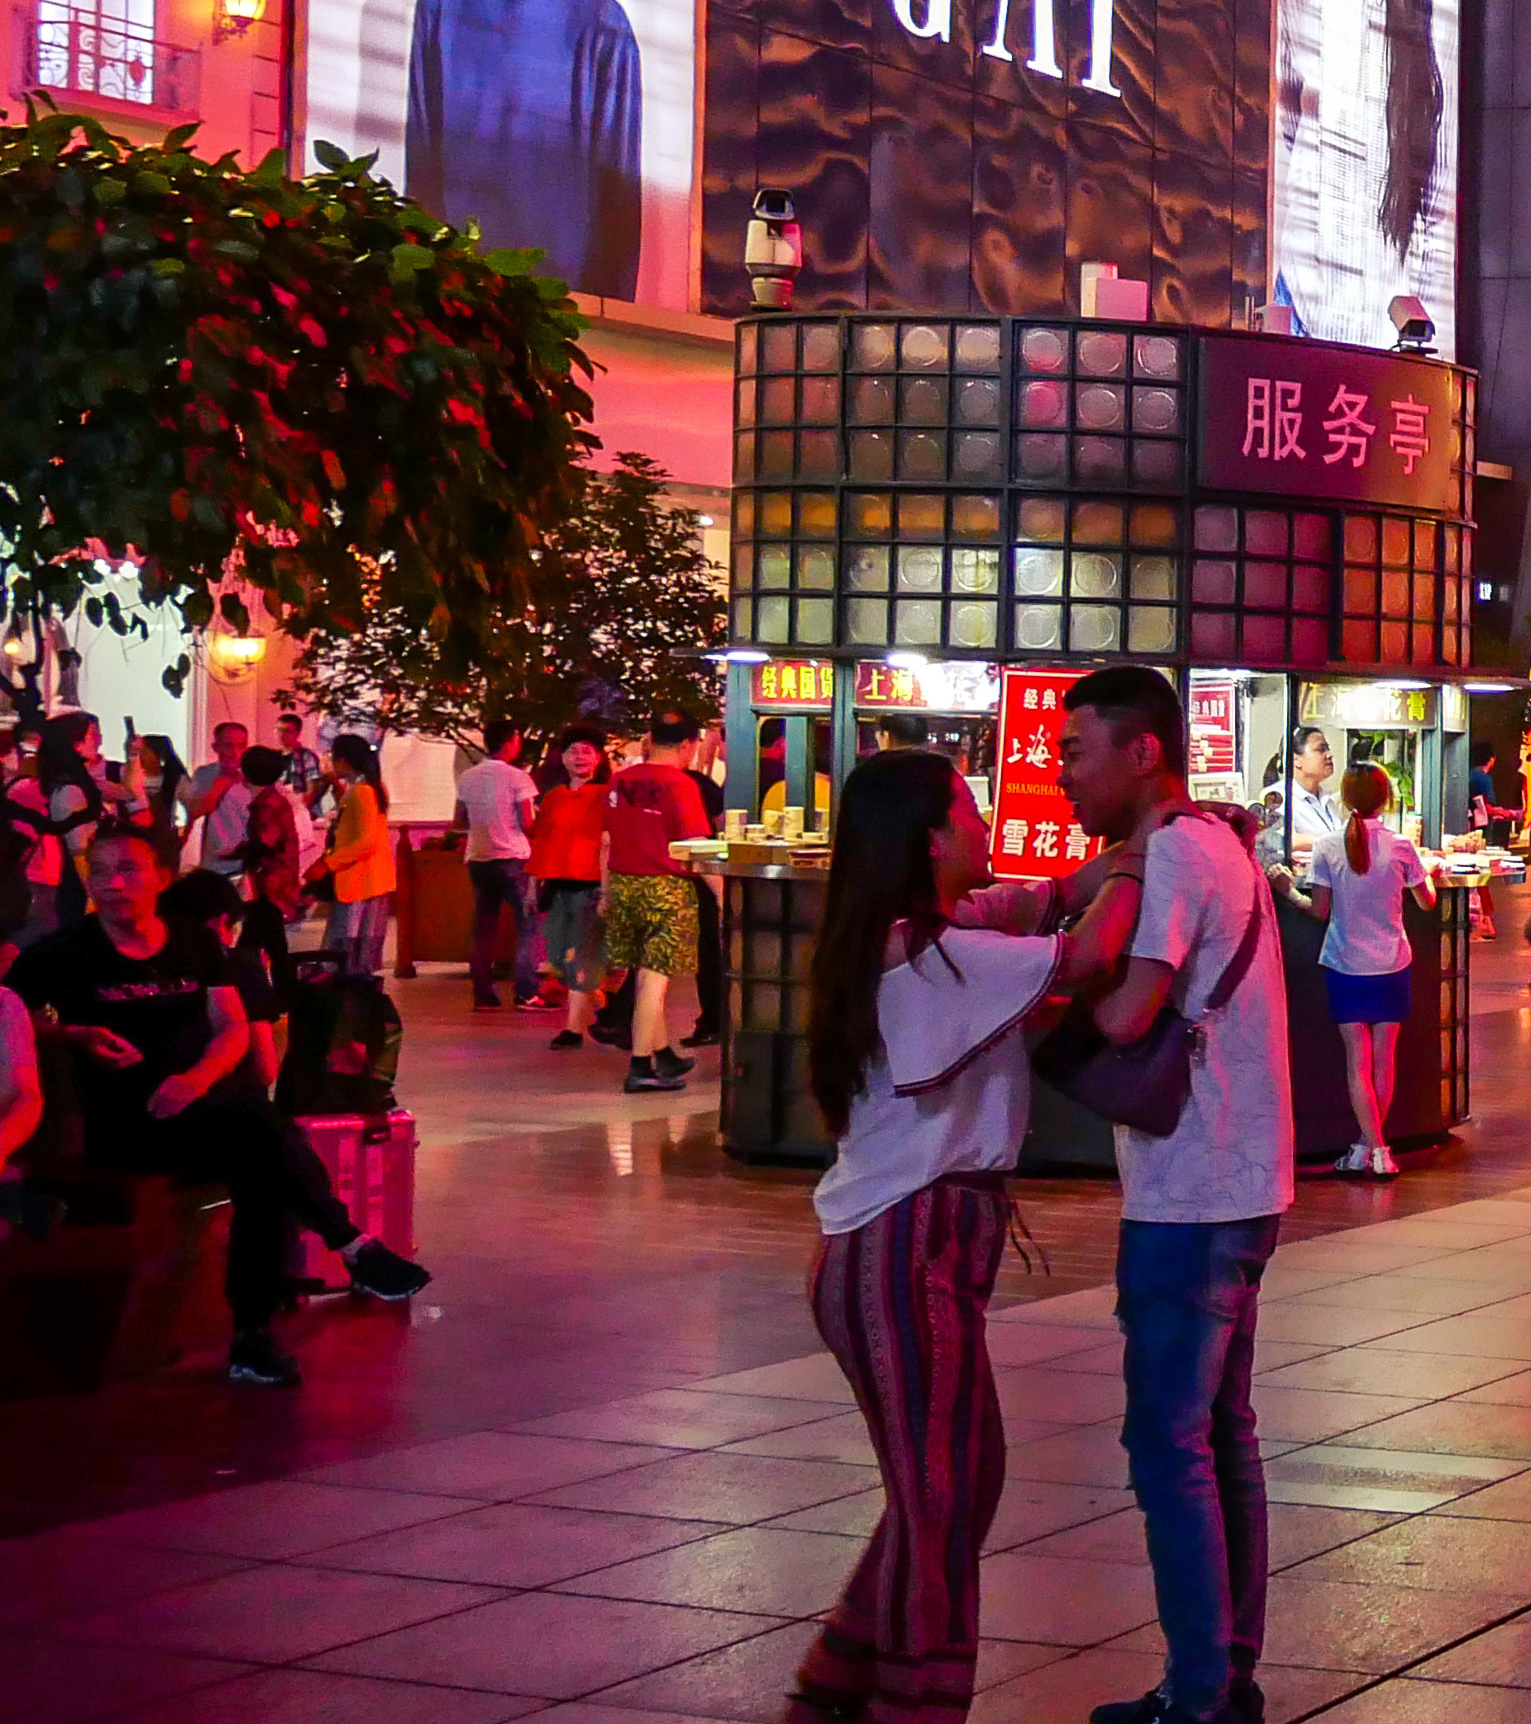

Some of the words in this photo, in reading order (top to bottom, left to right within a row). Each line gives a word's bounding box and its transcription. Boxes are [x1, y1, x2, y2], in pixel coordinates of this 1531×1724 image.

[1241, 377, 1431, 476] 服务亭
[761, 664, 834, 700] 经典国货
[1023, 688, 1068, 711] 经典
[1006, 724, 1064, 769] 上海
[1006, 782, 1059, 796] SHANGHAI
[1002, 818, 1092, 861] 雪花膏
